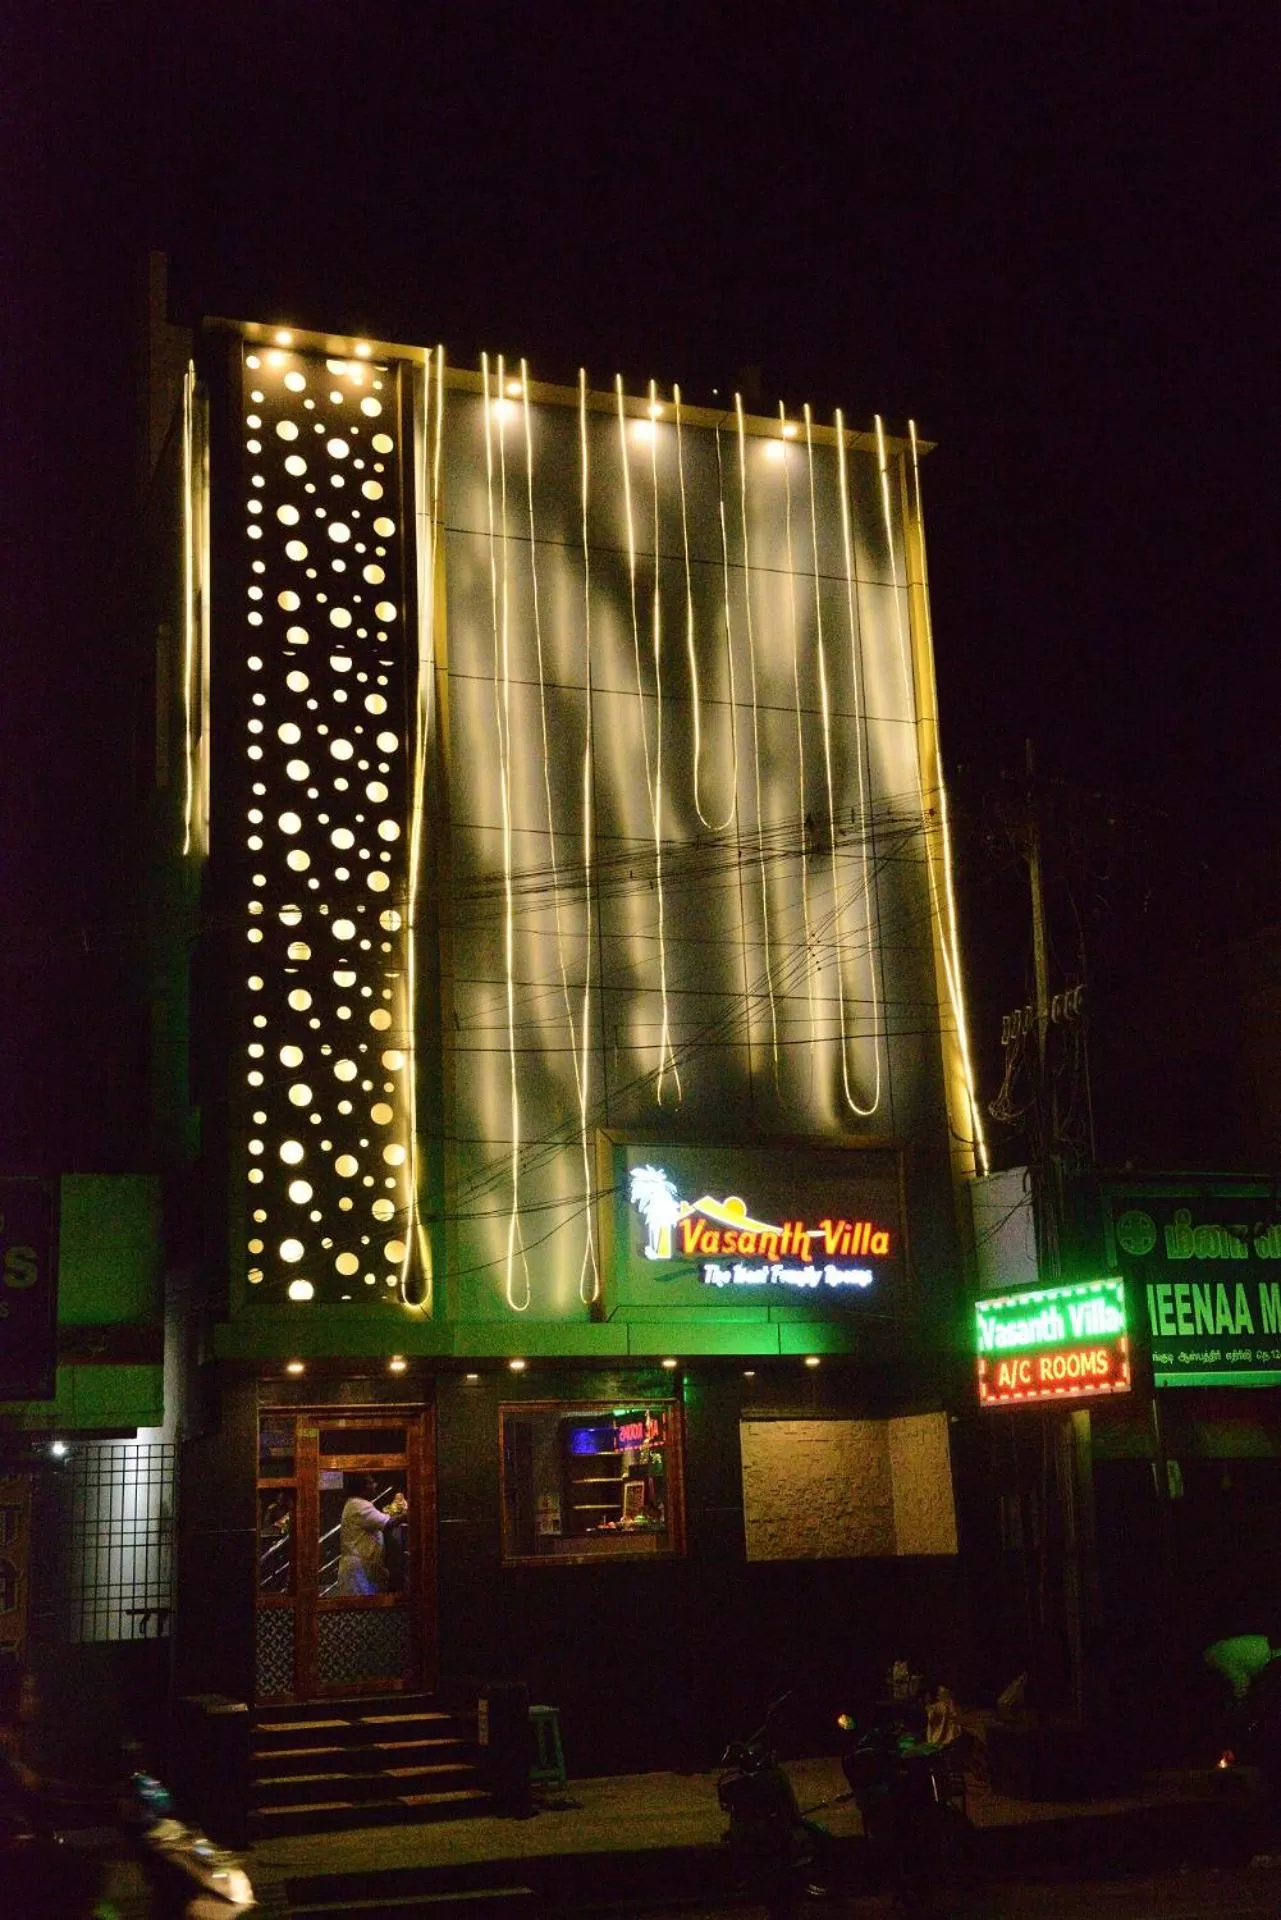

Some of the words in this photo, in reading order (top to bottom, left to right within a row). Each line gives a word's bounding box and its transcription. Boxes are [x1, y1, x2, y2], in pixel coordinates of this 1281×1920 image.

[678, 1217, 813, 1262] Vasanth
[819, 1218, 890, 1256] Villa
[980, 1305, 1065, 1350] Vasanth
[1068, 1297, 1122, 1337] Villa
[1147, 1283, 1255, 1336] EENAA
[998, 1358, 1031, 1389] A/C
[1040, 1349, 1109, 1381] ROOMS
